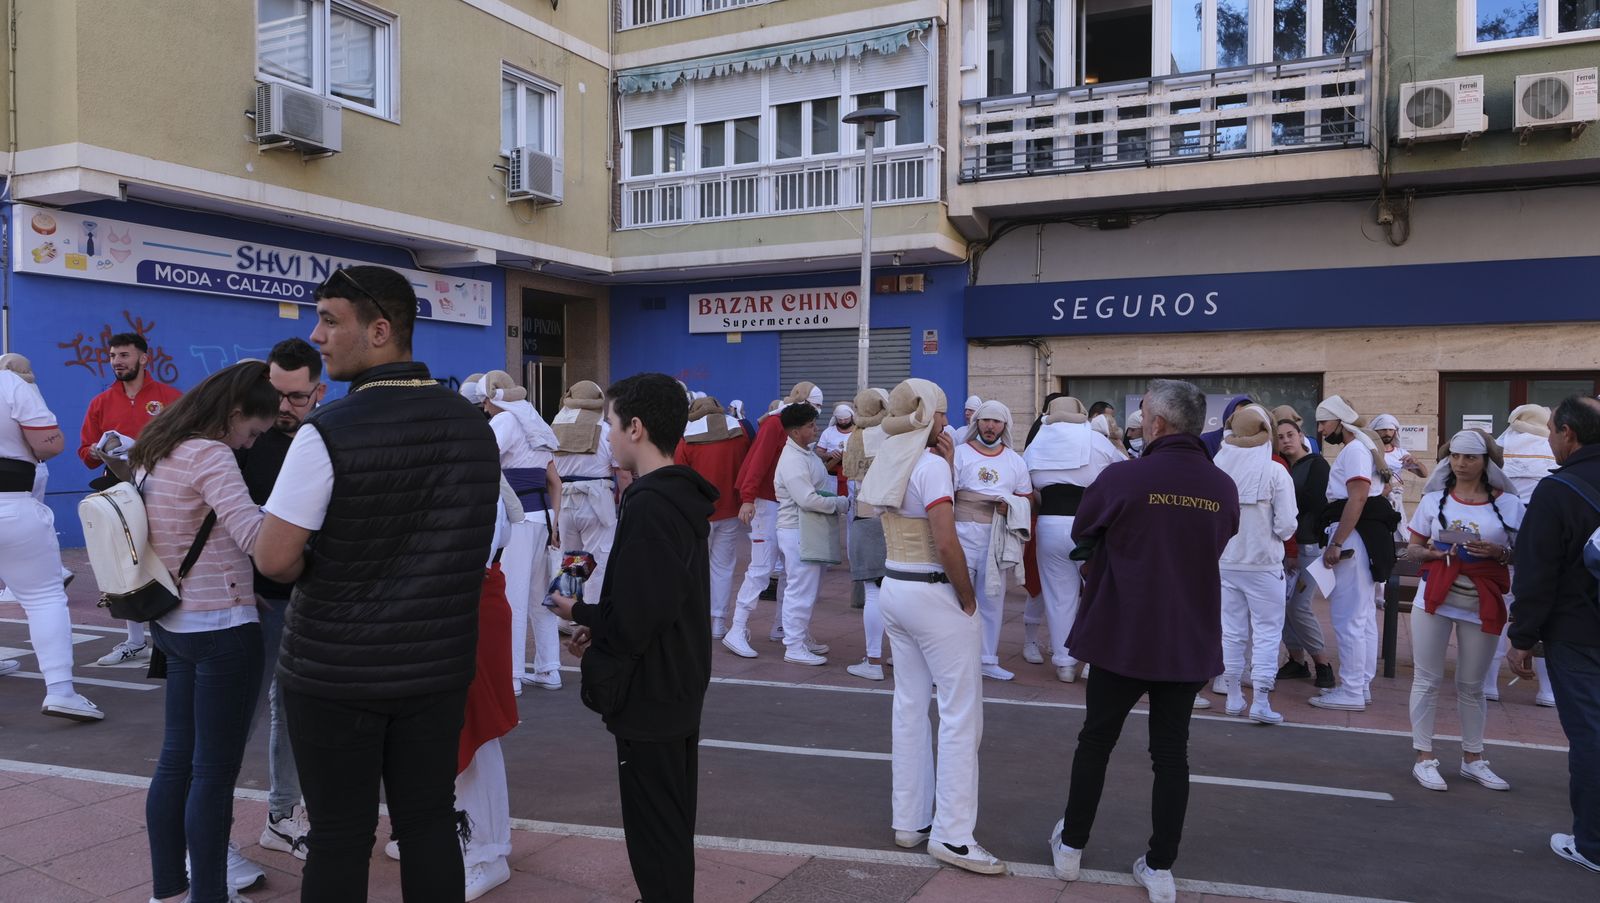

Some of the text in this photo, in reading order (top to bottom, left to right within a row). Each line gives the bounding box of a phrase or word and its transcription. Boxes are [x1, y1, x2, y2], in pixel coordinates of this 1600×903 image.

[154, 263, 305, 298] MODA CALZADO
[698, 290, 858, 316] BAZAR CHINO
[1052, 291, 1219, 321] SEGUROS
[511, 327, 517, 337] 5
[722, 314, 829, 329] Supermercado
[1148, 493, 1220, 512] ENCUENTRO
